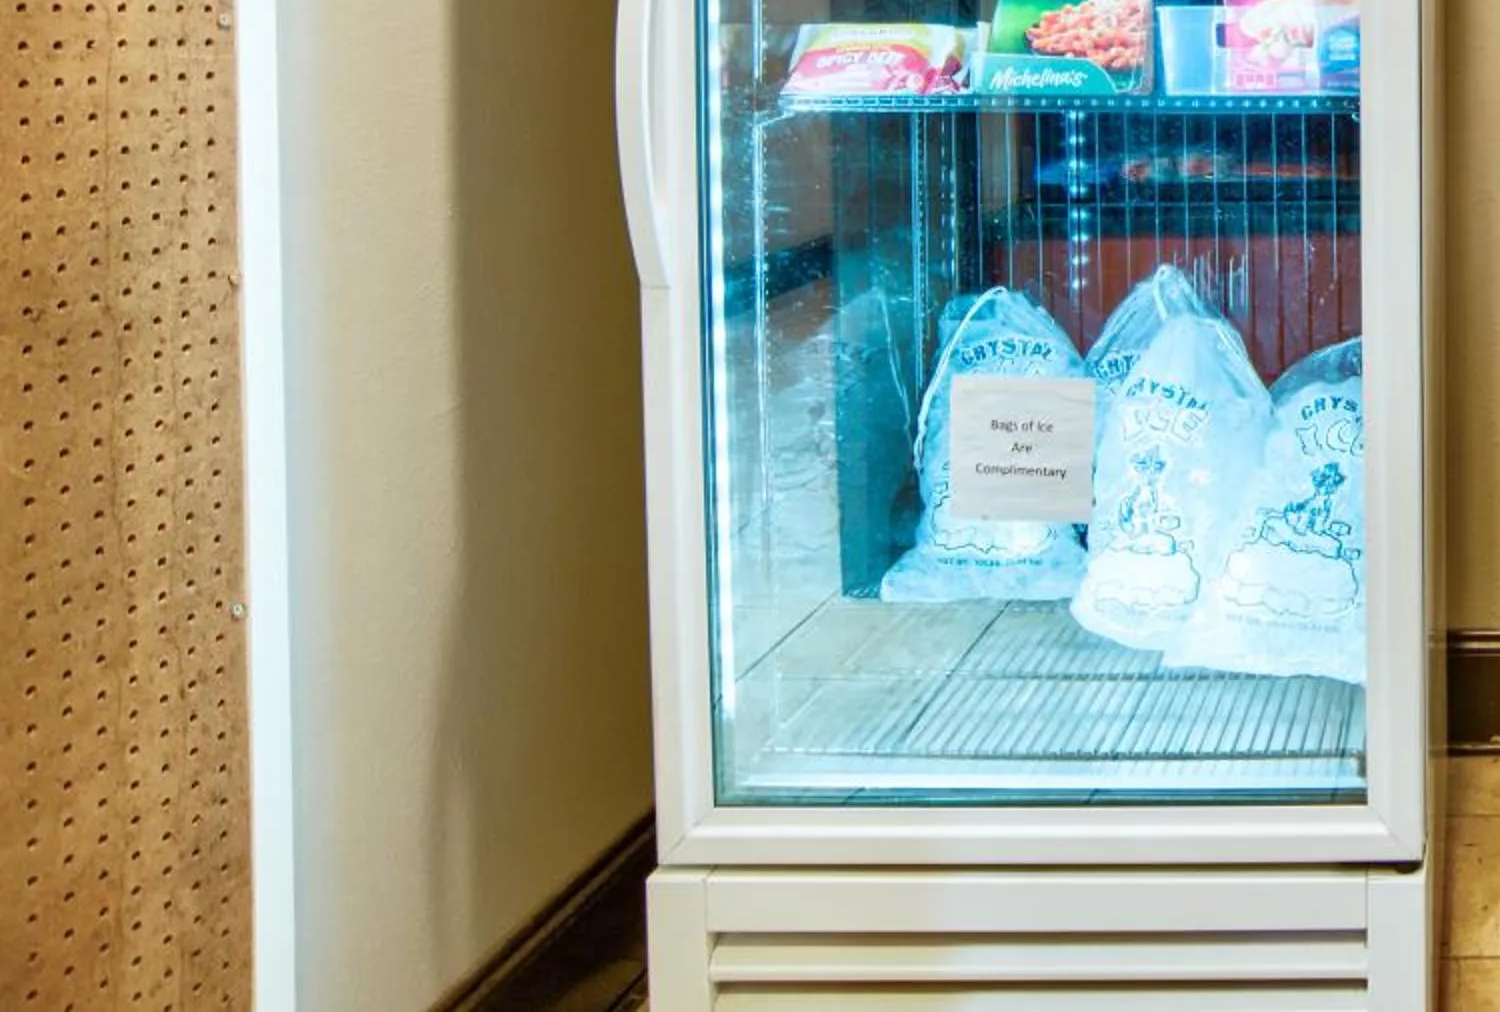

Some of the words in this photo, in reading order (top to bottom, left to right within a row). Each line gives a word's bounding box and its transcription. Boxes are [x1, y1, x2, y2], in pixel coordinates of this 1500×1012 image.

[990, 66, 1088, 91] Michelina's
[991, 419, 1019, 432] Bags
[1021, 419, 1035, 432] of
[1010, 441, 1033, 454] Are
[975, 463, 1068, 480] Complimentary
